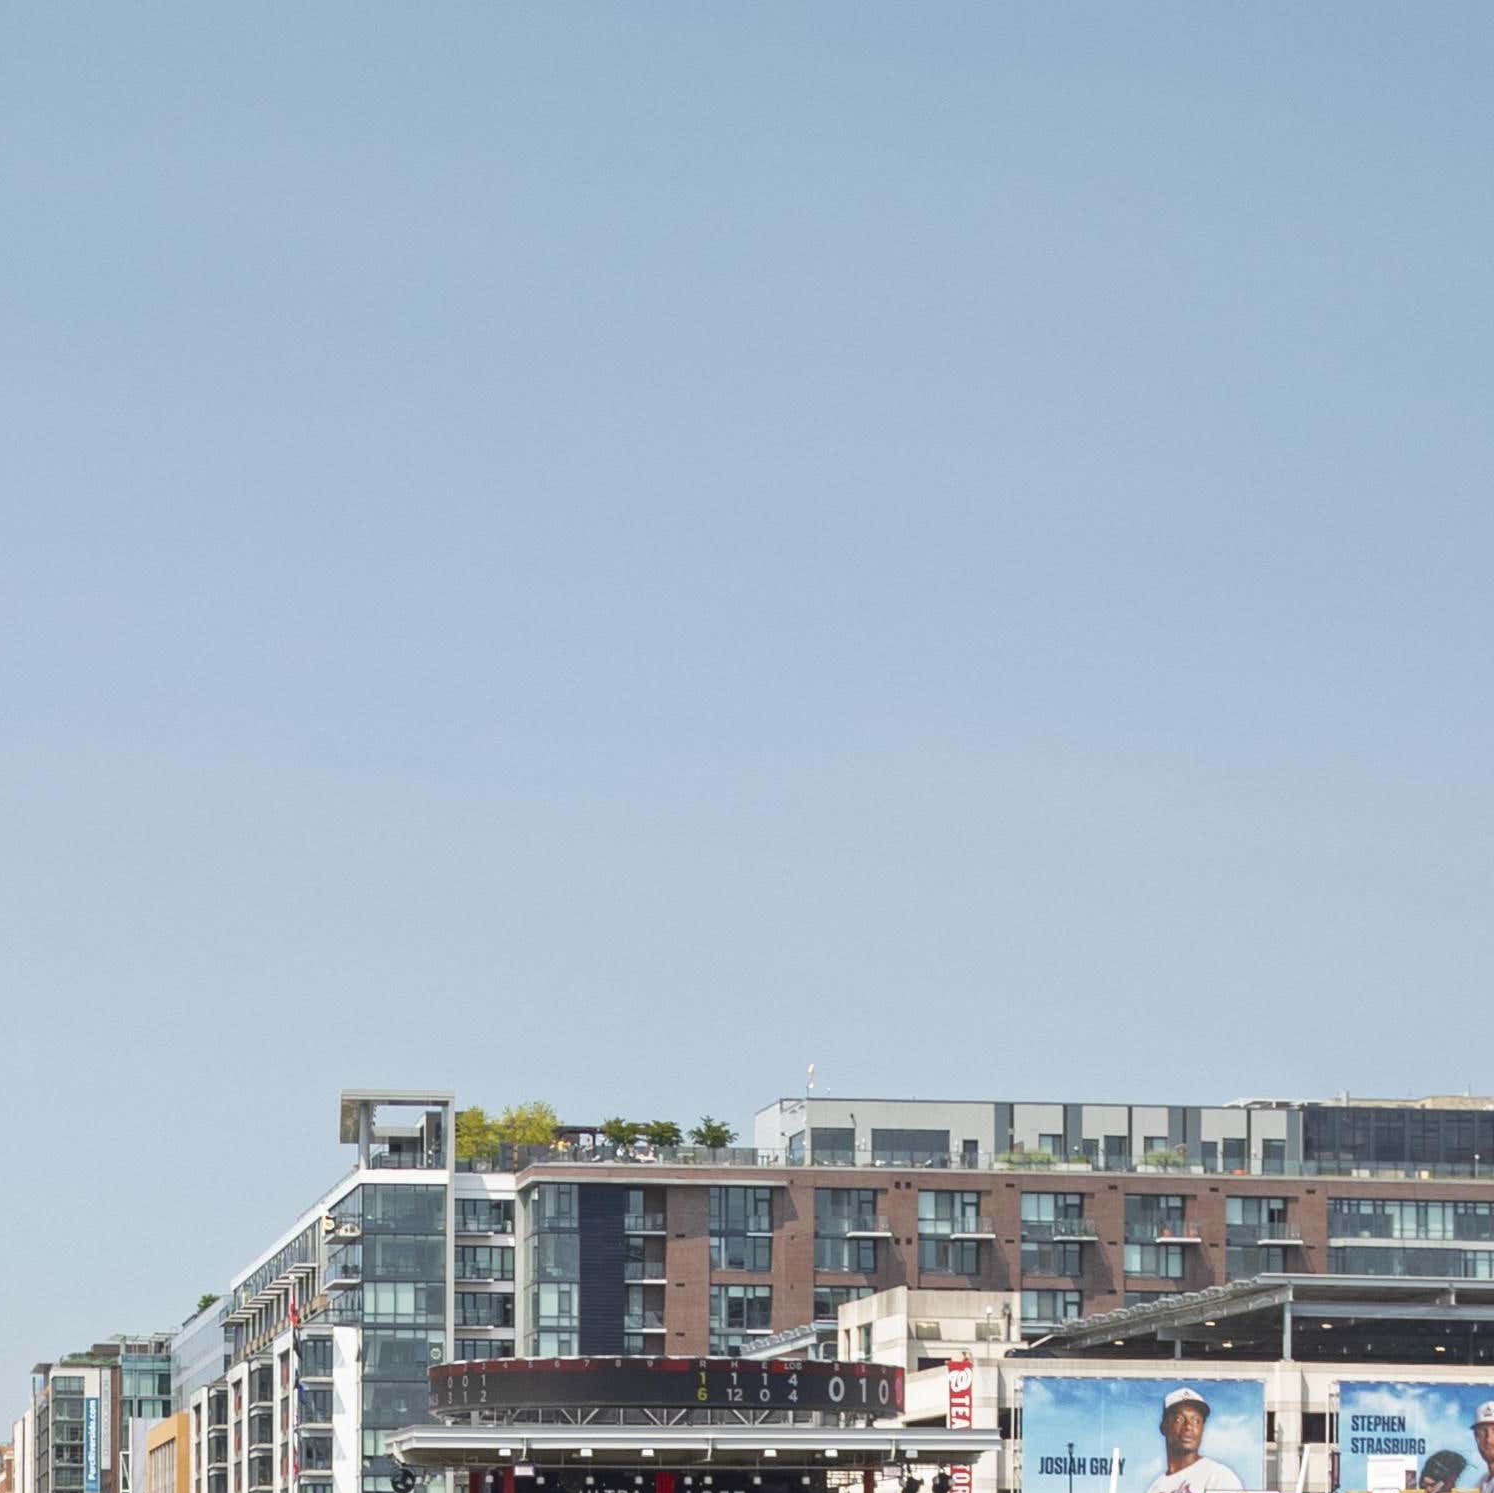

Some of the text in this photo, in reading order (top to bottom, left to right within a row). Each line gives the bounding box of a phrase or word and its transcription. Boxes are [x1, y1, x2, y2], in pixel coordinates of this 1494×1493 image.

[1350, 1416, 1406, 1433] STEPHEN
[1350, 1437, 1426, 1455] STRASBURG
[1038, 1458, 1086, 1475] JOSIAH
